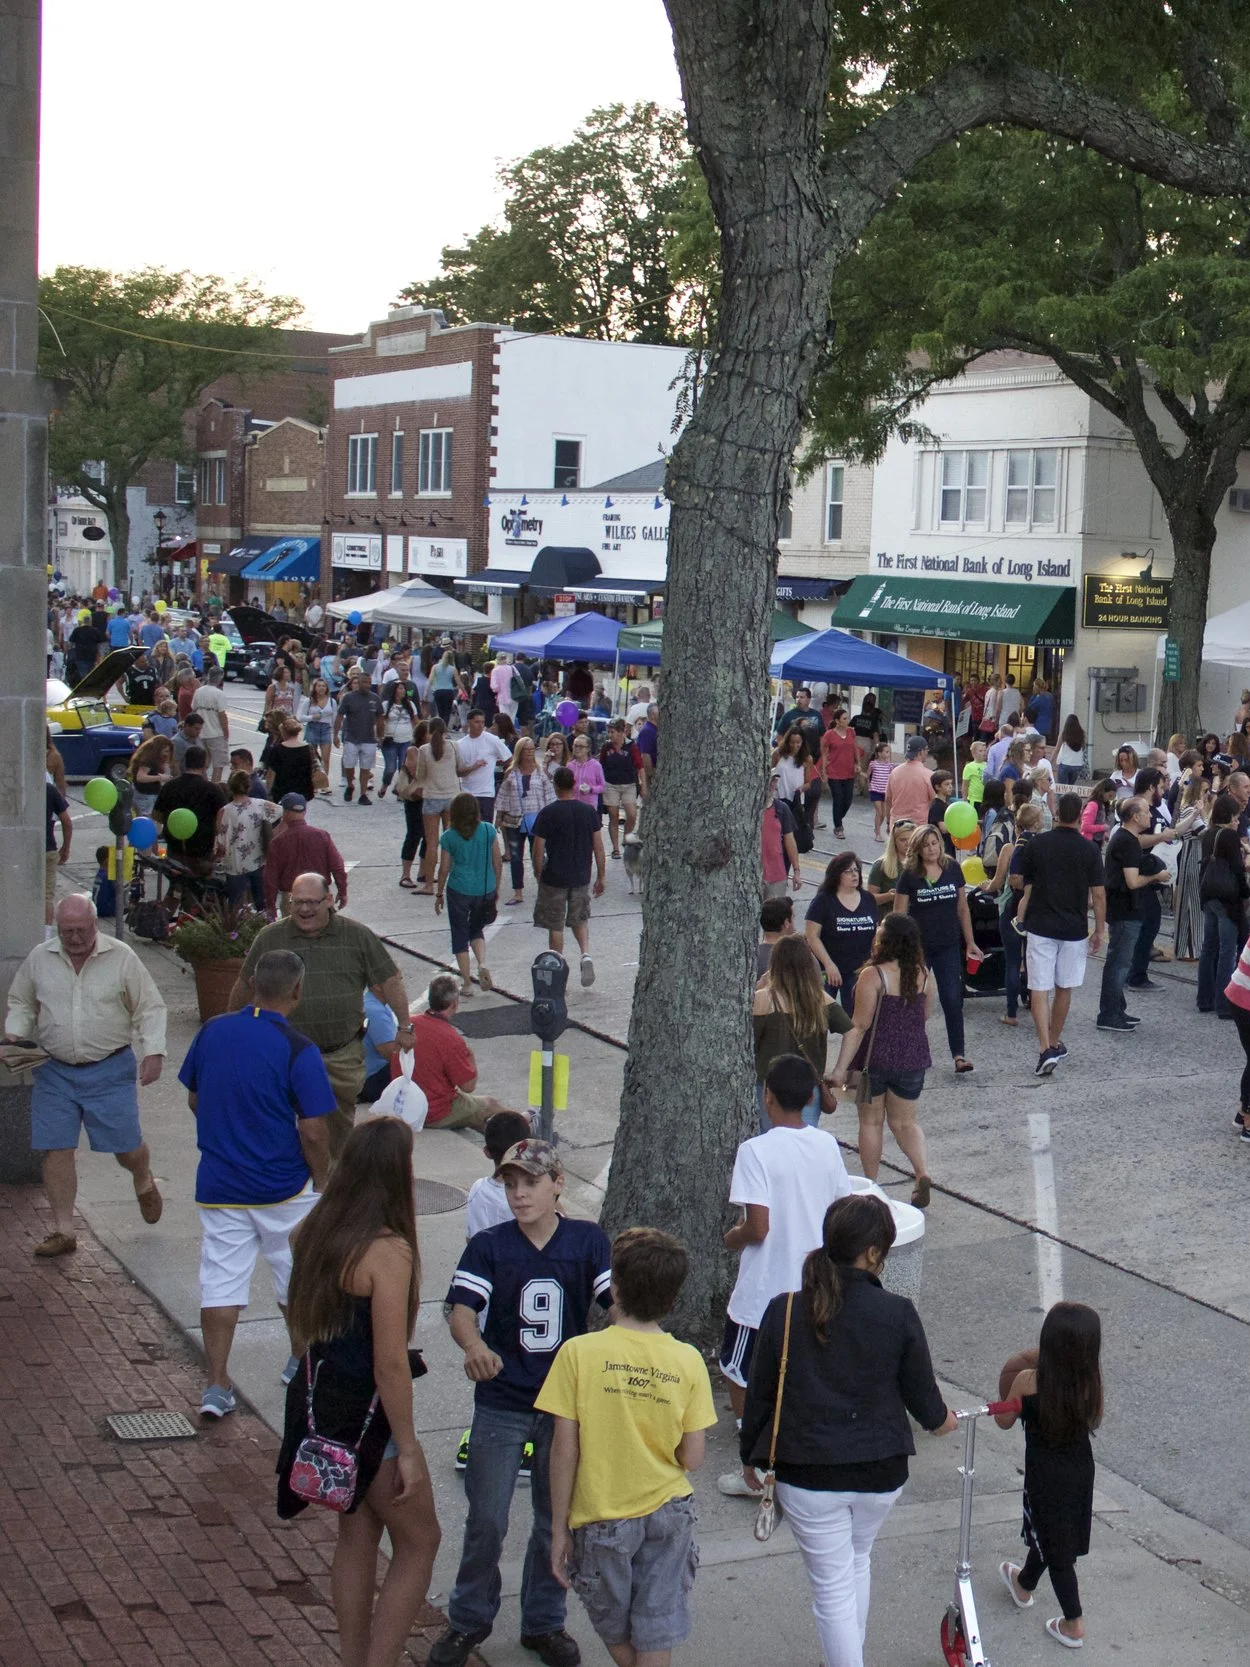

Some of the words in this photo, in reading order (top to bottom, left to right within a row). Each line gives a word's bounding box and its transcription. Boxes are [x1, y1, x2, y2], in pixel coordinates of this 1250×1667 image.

[605, 525, 636, 540] WILKES
[877, 552, 893, 568] The
[896, 553, 918, 569] First
[921, 555, 959, 572] National
[963, 556, 988, 574] Bank
[992, 557, 1005, 575] of
[1007, 559, 1033, 581] Long
[1037, 559, 1071, 577] Island
[776, 587, 792, 596] GIFTS
[1099, 583, 1114, 593] The
[1114, 583, 1133, 593] First
[1135, 585, 1164, 595] National
[880, 596, 895, 609] The
[894, 597, 914, 610] First
[912, 598, 942, 613] National
[940, 600, 963, 615] Bank
[961, 601, 975, 616] of
[970, 602, 991, 620] Long
[990, 604, 1021, 619] Island
[1094, 594, 1113, 604] Bank
[1116, 594, 1124, 605] of
[1126, 596, 1144, 608] Long
[1146, 597, 1168, 606] Island
[1098, 614, 1107, 622] 24
[1108, 615, 1129, 623] HOUR
[1130, 616, 1163, 624] BANKING
[917, 886, 950, 894] SIGNATURE
[519, 1278, 564, 1353] 9
[602, 1361, 649, 1375] Jamestowne
[650, 1367, 680, 1384] Virginia
[628, 1376, 650, 1389] 1607
